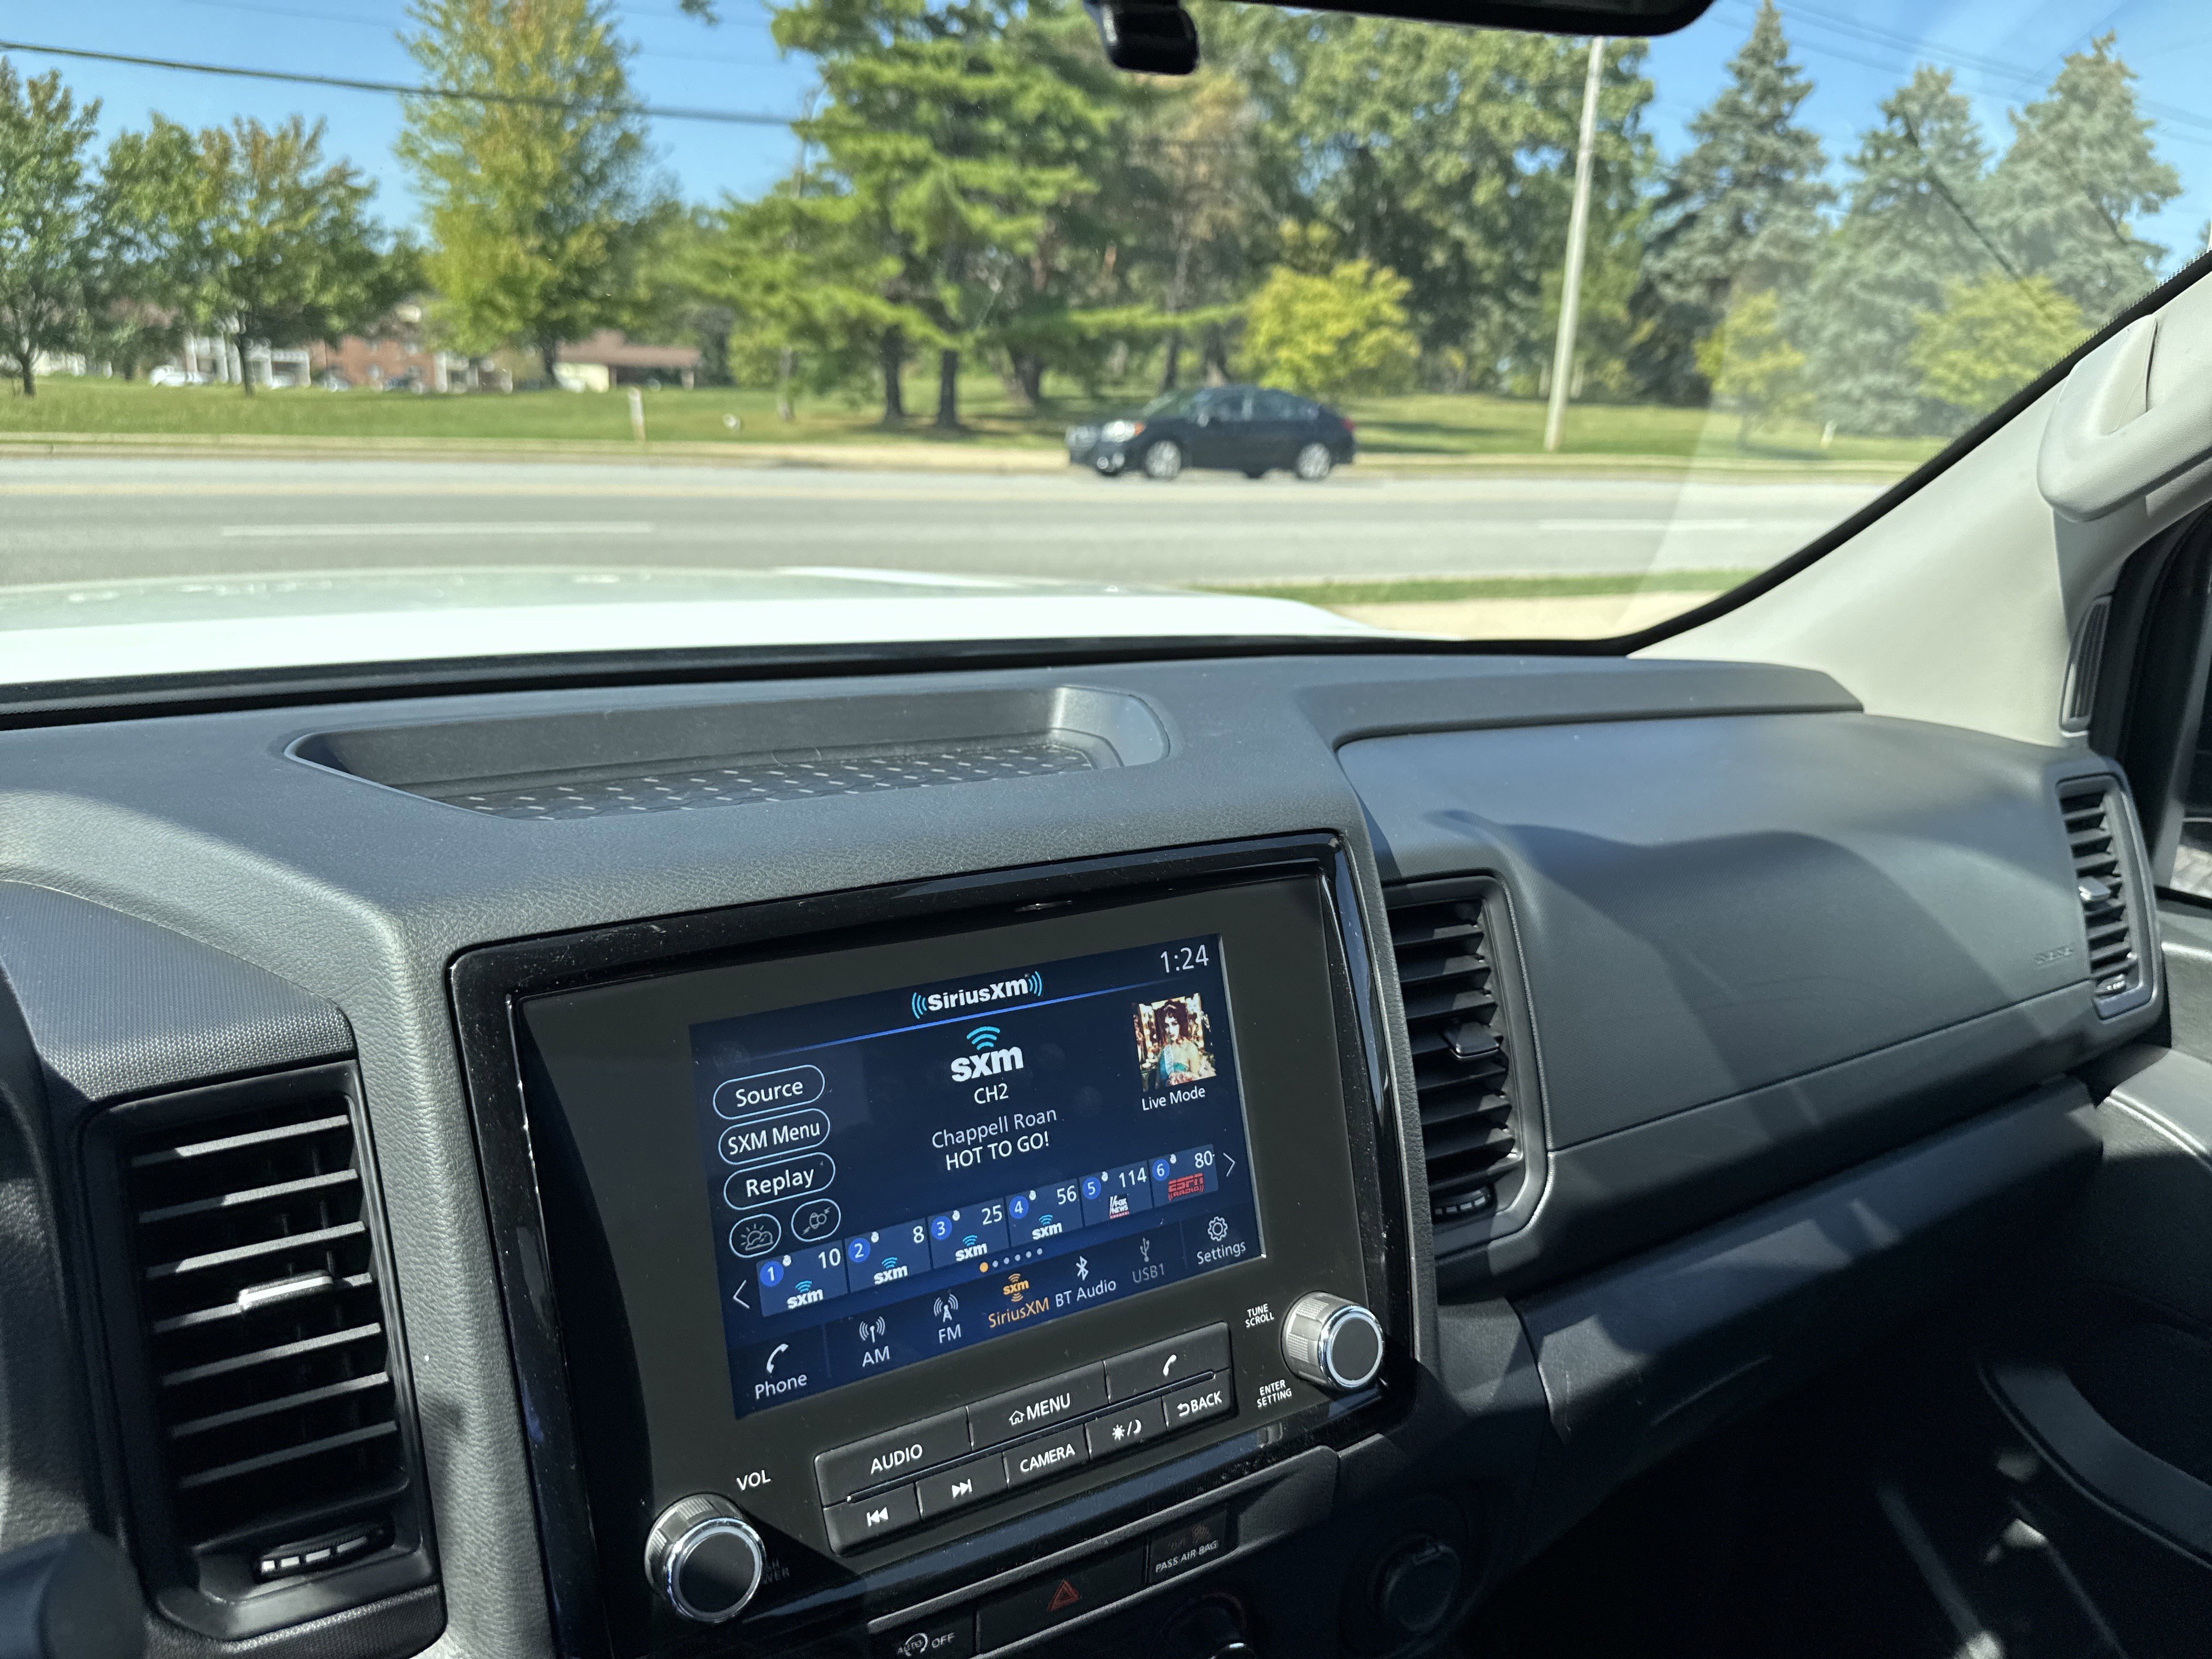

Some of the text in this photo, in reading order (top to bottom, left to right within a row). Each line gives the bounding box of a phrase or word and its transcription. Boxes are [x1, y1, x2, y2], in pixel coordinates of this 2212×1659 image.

[1160, 944, 1209, 973] 1:24
[736, 1081, 804, 1107] Source
[974, 1083, 1009, 1104] CH2
[1142, 1085, 1206, 1111] Live Mode
[728, 1121, 821, 1155] SXM Menu
[932, 1109, 1057, 1148] Chappell Roan
[946, 1131, 1050, 1170] HOT TO GO!
[1156, 1150, 1213, 1177] 6 80
[746, 1167, 814, 1197] Replay
[1087, 1167, 1147, 1195] 5 114
[1168, 1172, 1203, 1192] ESPN
[1173, 1186, 1199, 1198] RADIO
[1014, 1184, 1076, 1214] 4 56
[936, 1205, 1003, 1236] 3 25
[856, 1225, 925, 1259] 2 8
[1197, 1241, 1246, 1265] Settings
[819, 1248, 841, 1269] 10
[1133, 1263, 1165, 1283] USB1
[1055, 1279, 1117, 1308] BT Audio
[988, 1297, 1049, 1328] SiriusXM
[1245, 1312, 1274, 1328] SCROLL
[1247, 1304, 1268, 1318] TUNE
[939, 1324, 962, 1344] FM
[862, 1346, 890, 1367] AM
[755, 1374, 808, 1400] Phone
[1257, 1388, 1292, 1408] SETTING
[1260, 1379, 1285, 1396] ENTER
[1026, 1393, 1071, 1421] MENU
[1190, 1391, 1222, 1413] BACK
[871, 1444, 923, 1474] AUDIO
[1020, 1444, 1075, 1472] CAMERA
[736, 1470, 771, 1491] VOL
[1156, 1556, 1179, 1573] PASS
[1181, 1549, 1197, 1562] AIR
[1199, 1539, 1218, 1555] BAG
[932, 1632, 955, 1648] OFF
